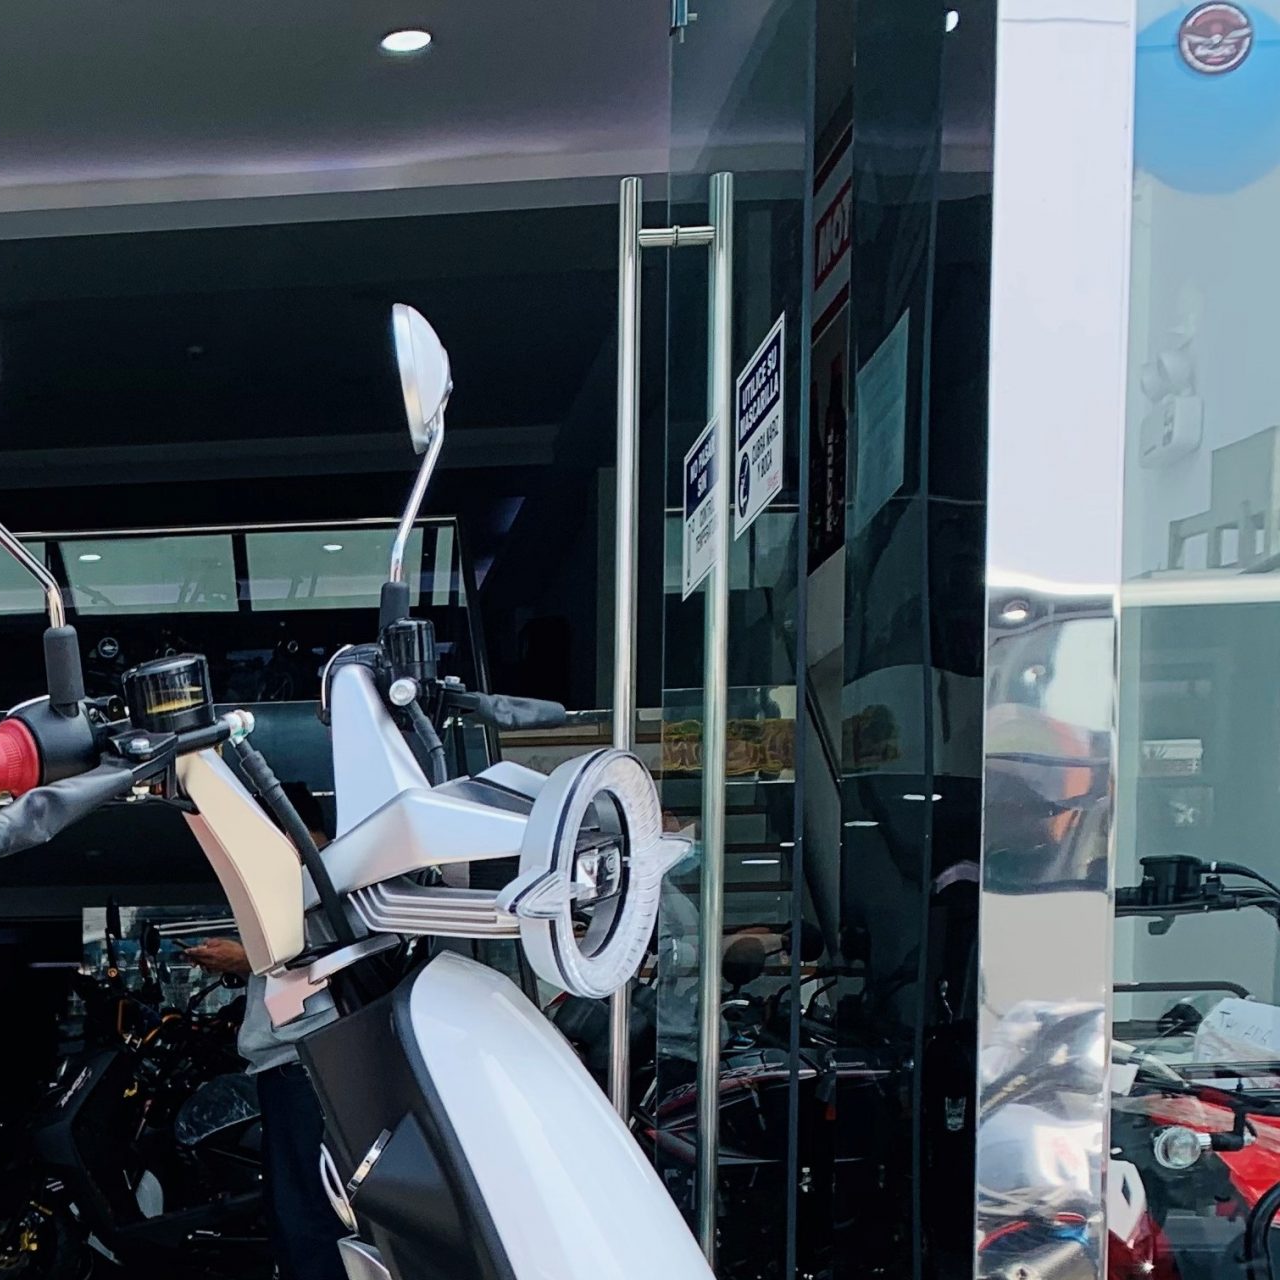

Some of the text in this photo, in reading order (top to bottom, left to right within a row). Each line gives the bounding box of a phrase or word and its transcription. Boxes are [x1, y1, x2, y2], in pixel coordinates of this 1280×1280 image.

[742, 345, 778, 411] UTILICE SU
[740, 371, 779, 441] MASCARILLA
[690, 459, 698, 485] NO
[697, 470, 707, 498] SIN
